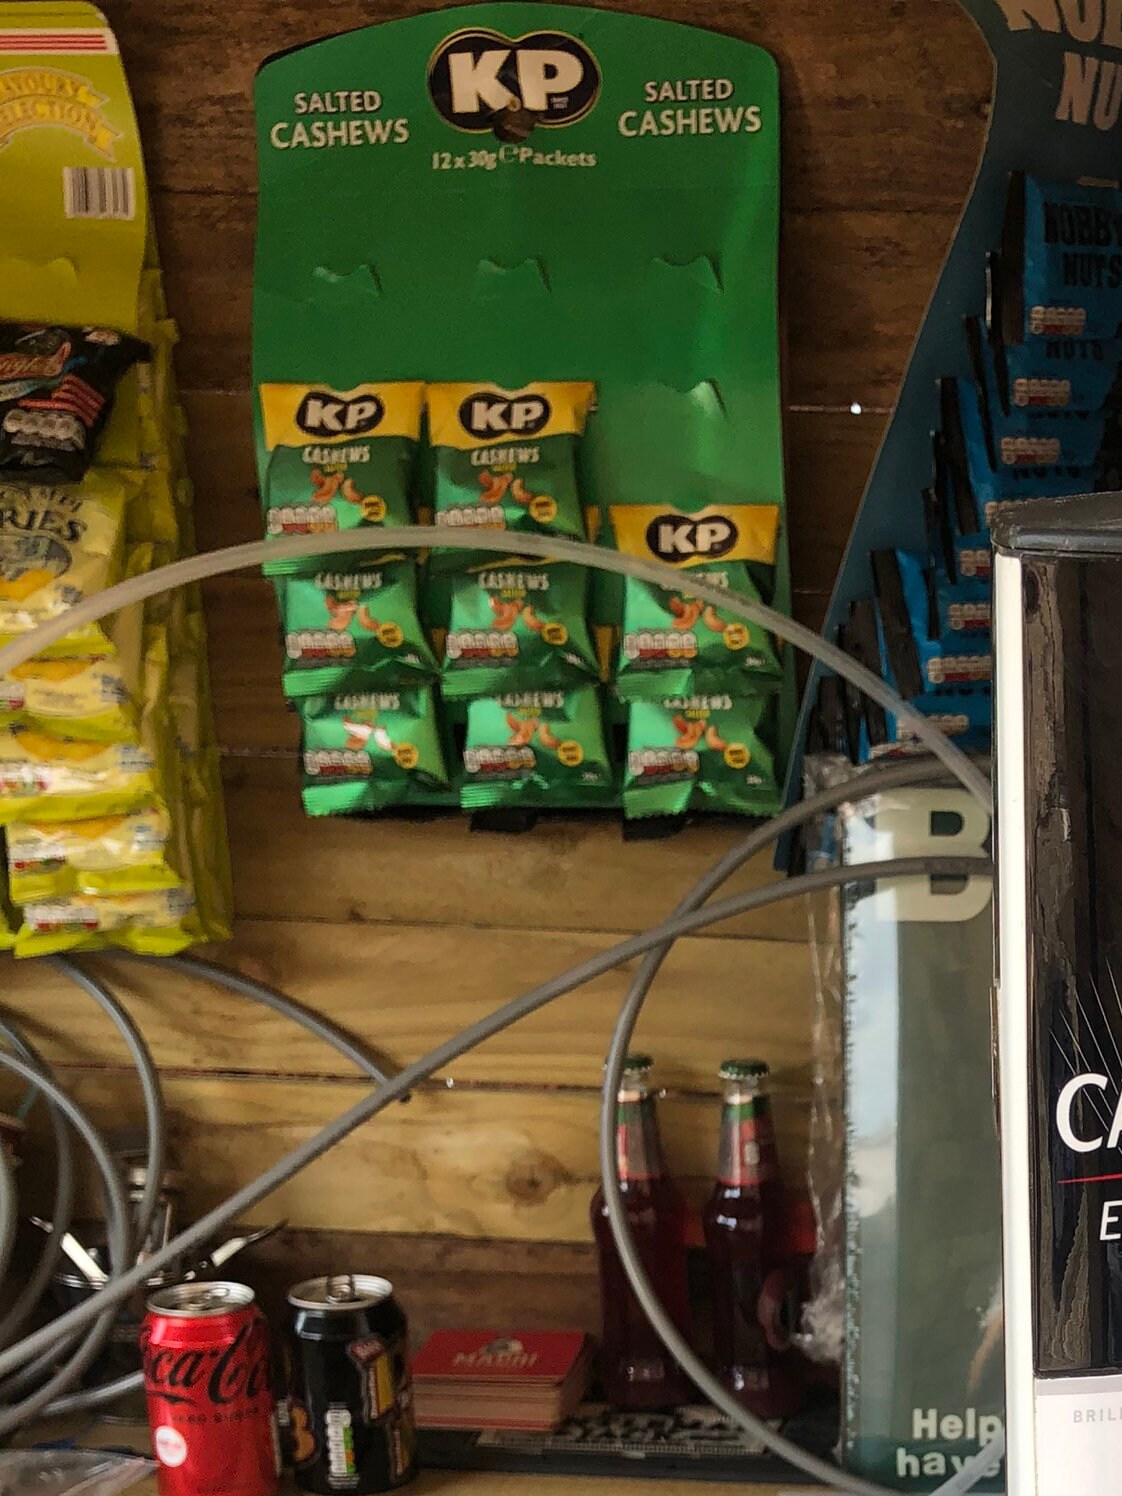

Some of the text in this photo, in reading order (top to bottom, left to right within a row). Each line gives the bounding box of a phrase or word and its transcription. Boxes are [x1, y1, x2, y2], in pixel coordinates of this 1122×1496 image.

[448, 49, 585, 114] KP
[643, 78, 735, 103] SALTED
[293, 90, 383, 115] SALTED
[269, 117, 411, 150] CASHEWS
[617, 105, 762, 138] CASHEWS
[304, 399, 378, 430] KP
[470, 399, 545, 431] KP
[658, 522, 732, 553] KP
[912, 1407, 1003, 1448] Help
